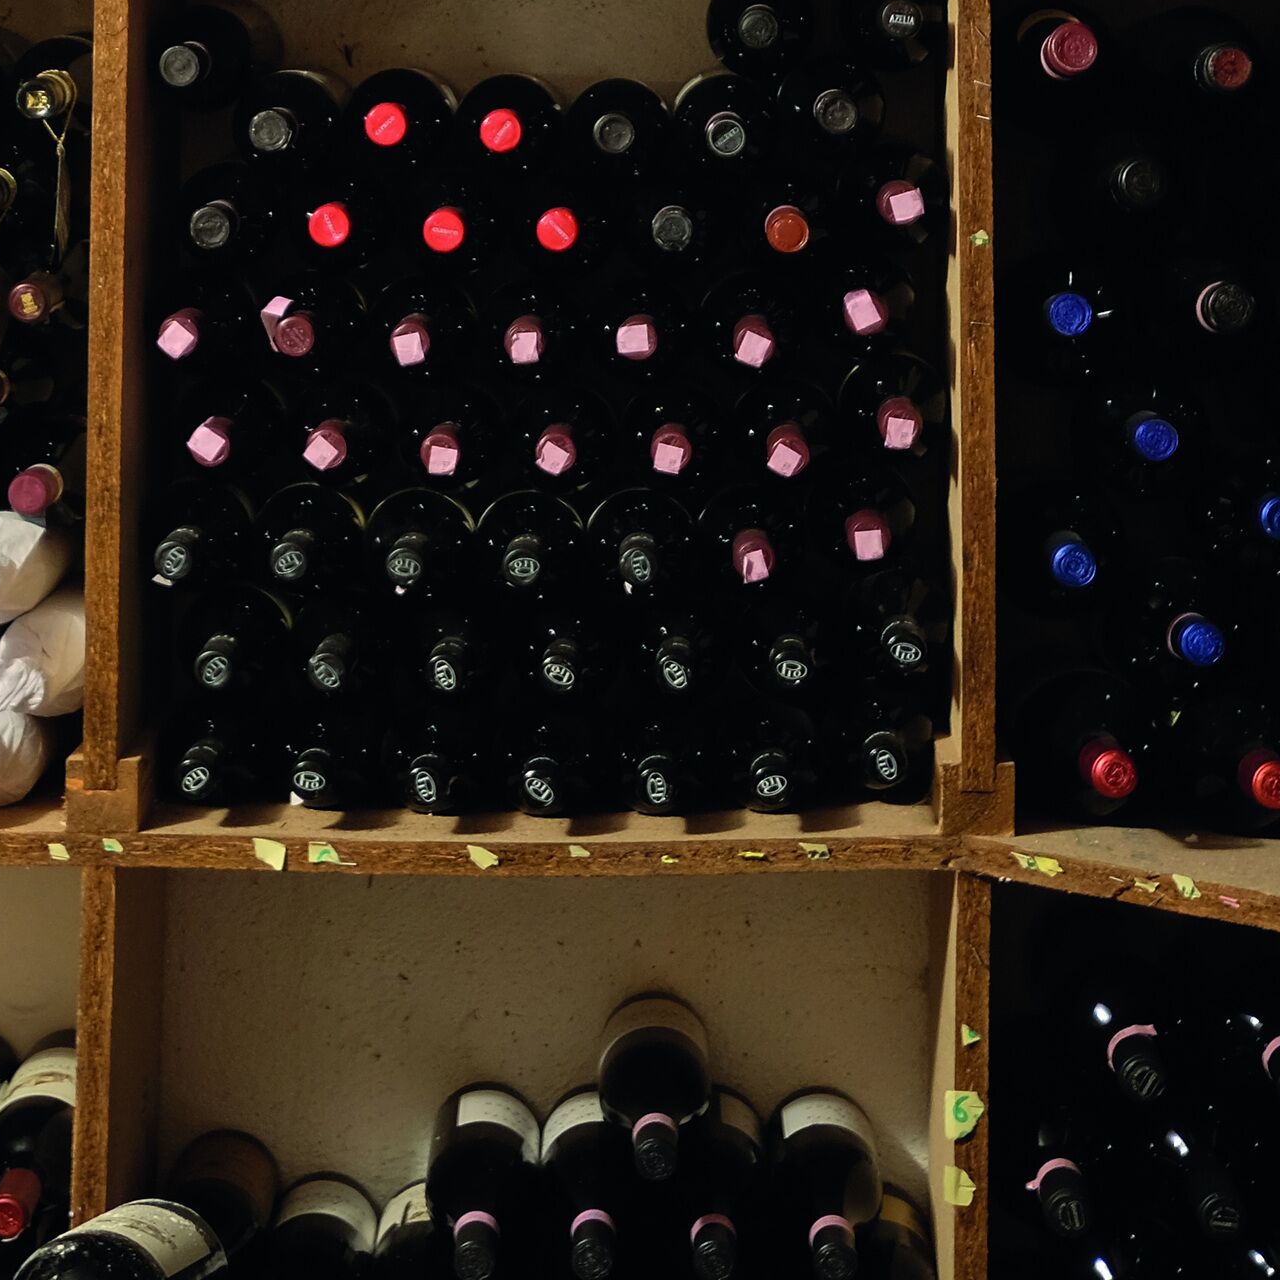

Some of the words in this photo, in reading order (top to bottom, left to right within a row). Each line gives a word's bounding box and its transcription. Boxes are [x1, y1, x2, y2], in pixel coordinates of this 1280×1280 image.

[889, 14, 914, 25] AZELIA
[165, 549, 185, 573] Pio
[277, 553, 302, 572] Pio
[391, 560, 418, 574] Pio
[511, 559, 538, 575] Pio
[633, 552, 648, 579] Pio
[892, 644, 919, 660] Pio
[205, 658, 226, 681] Pio
[316, 663, 338, 685] Pio
[437, 662, 454, 687] Pio
[546, 665, 572, 683] Pio
[665, 662, 685, 686] Pio
[779, 662, 805, 677] Pio
[878, 752, 896, 778] Pio
[184, 768, 207, 790] Pio
[296, 773, 323, 789] Pio
[418, 773, 435, 800] Pio
[527, 779, 552, 800] Pio
[649, 774, 664, 801] Pio
[759, 777, 785, 794] Pio
[954, 1096, 969, 1122] 6
